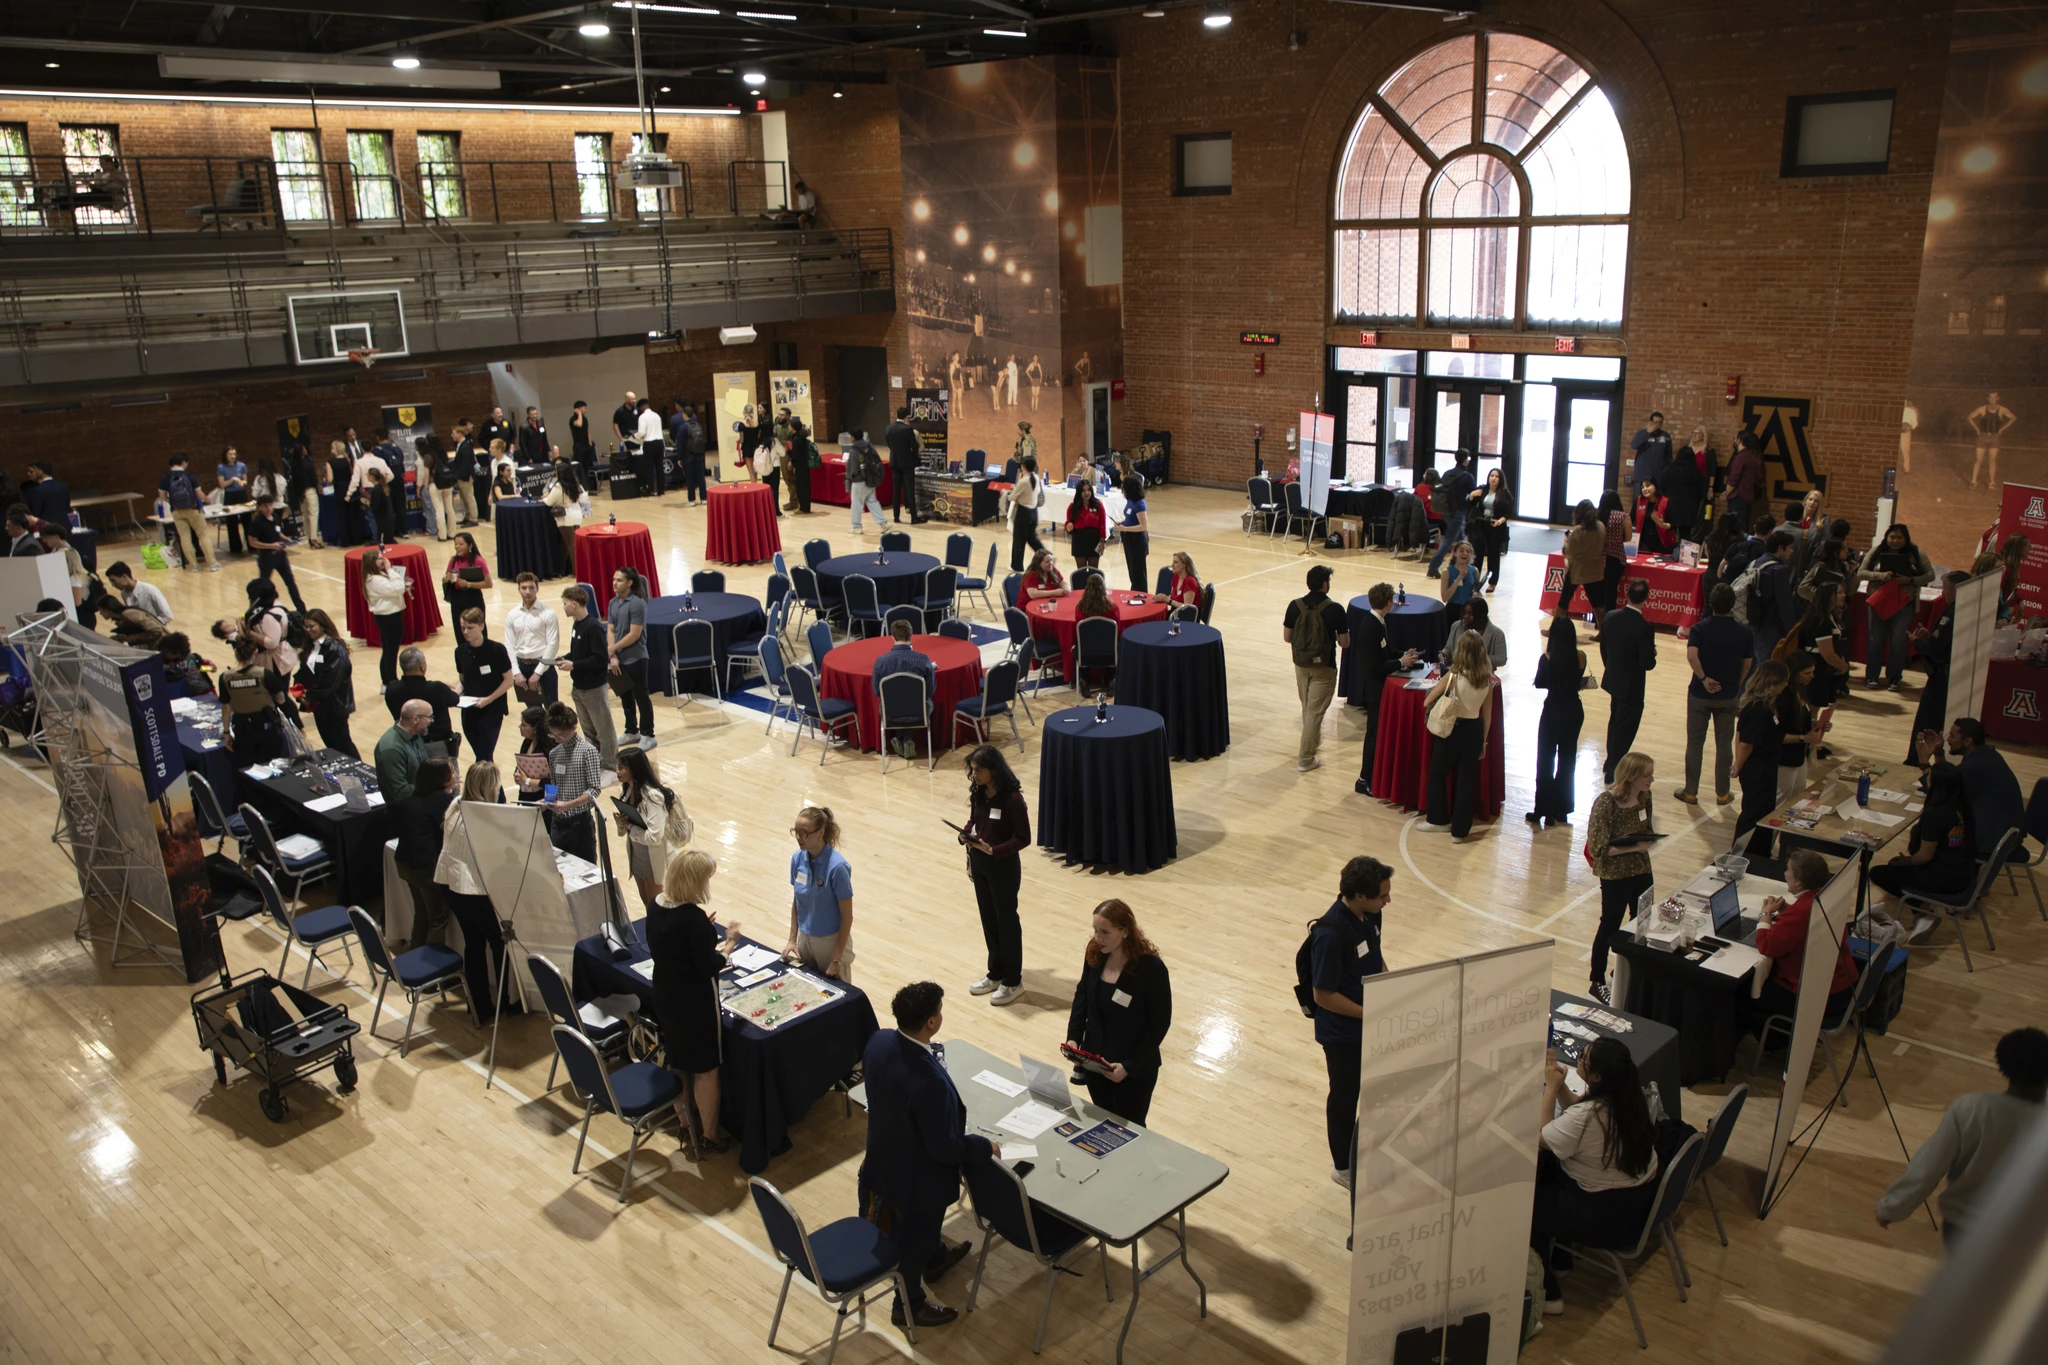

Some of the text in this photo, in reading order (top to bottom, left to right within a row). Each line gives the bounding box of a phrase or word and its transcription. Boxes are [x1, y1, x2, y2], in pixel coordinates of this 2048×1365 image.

[2024, 496, 2046, 519] A
[1544, 567, 1565, 592] A
[1580, 591, 1589, 600] &
[1641, 601, 1701, 616] evelopment
[2003, 688, 2041, 721] A
[144, 707, 167, 778] SCOTTSDALE PD
